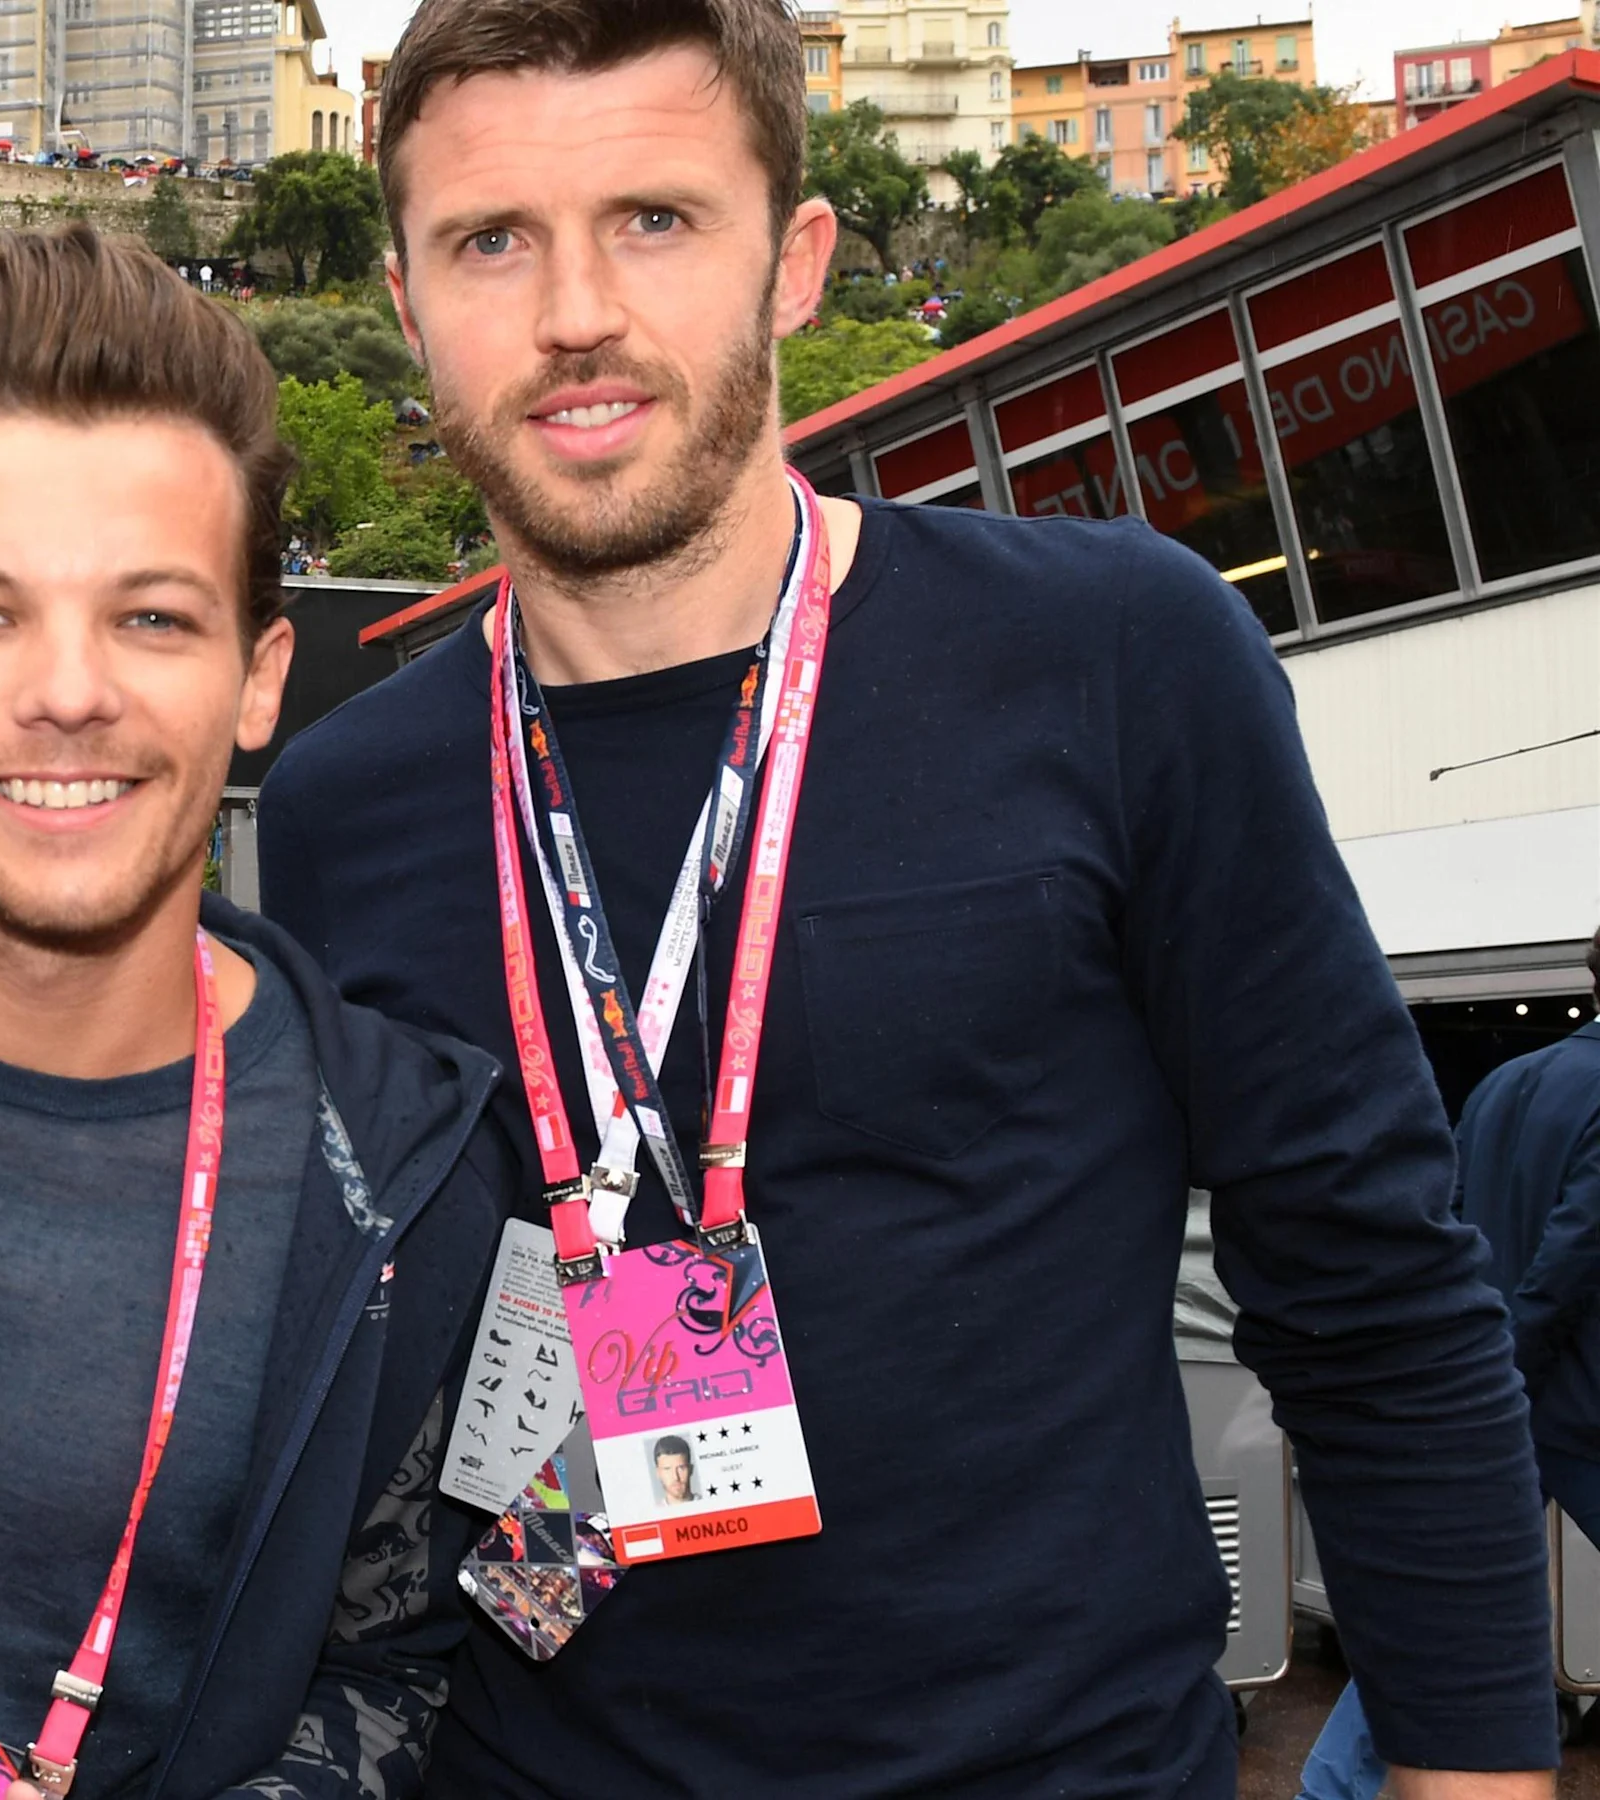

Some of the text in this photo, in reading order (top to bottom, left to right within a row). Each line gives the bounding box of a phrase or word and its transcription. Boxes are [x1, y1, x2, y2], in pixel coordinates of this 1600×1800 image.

[714, 811, 734, 863] Monaco
[565, 843, 582, 885] Monaco
[523, 1511, 575, 1564] Monaco
[675, 1517, 749, 1543] MONACO
